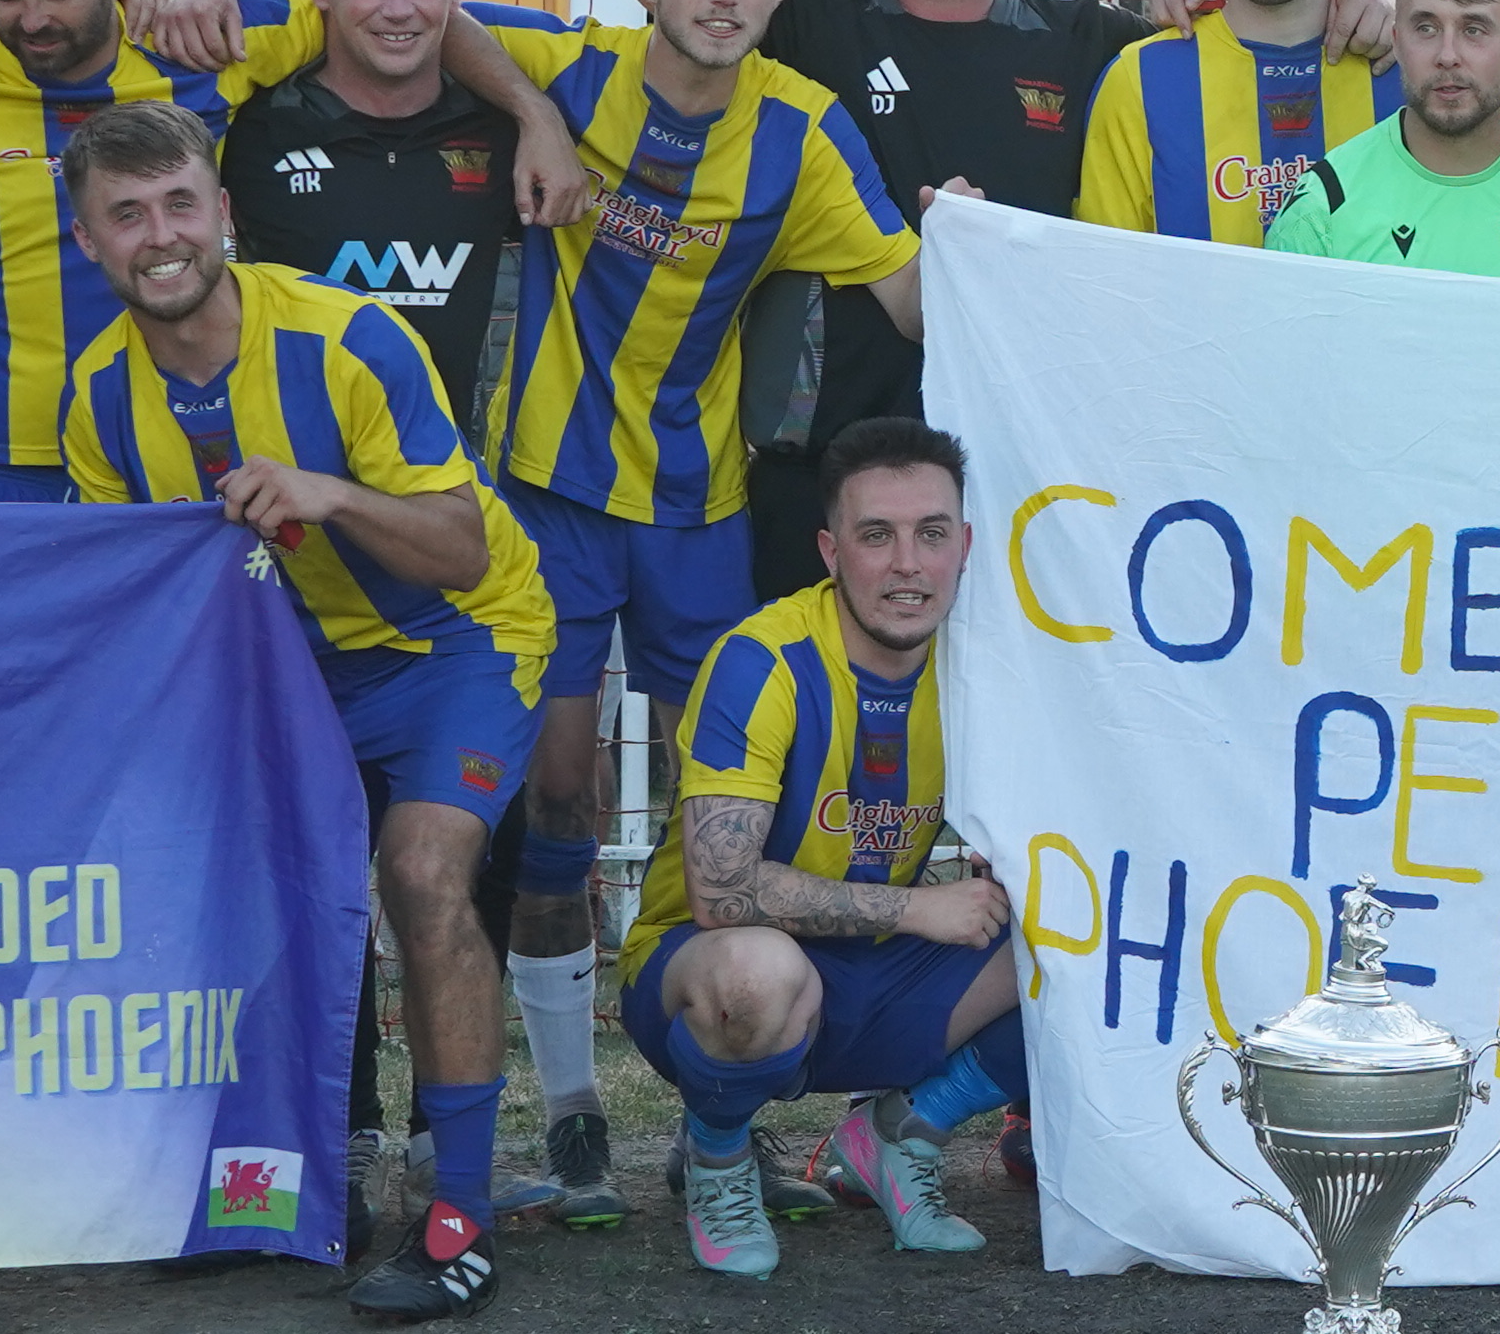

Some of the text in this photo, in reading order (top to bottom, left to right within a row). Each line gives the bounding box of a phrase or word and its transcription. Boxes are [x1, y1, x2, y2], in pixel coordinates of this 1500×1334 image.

[1263, 64, 1317, 78] EXILE
[871, 94, 896, 115] DJ
[648, 125, 700, 151] EXILE
[289, 171, 322, 194] AK
[596, 210, 687, 261] HALL
[325, 240, 474, 290] NW
[173, 397, 226, 415] EXILE
[862, 700, 908, 713] EXILE
